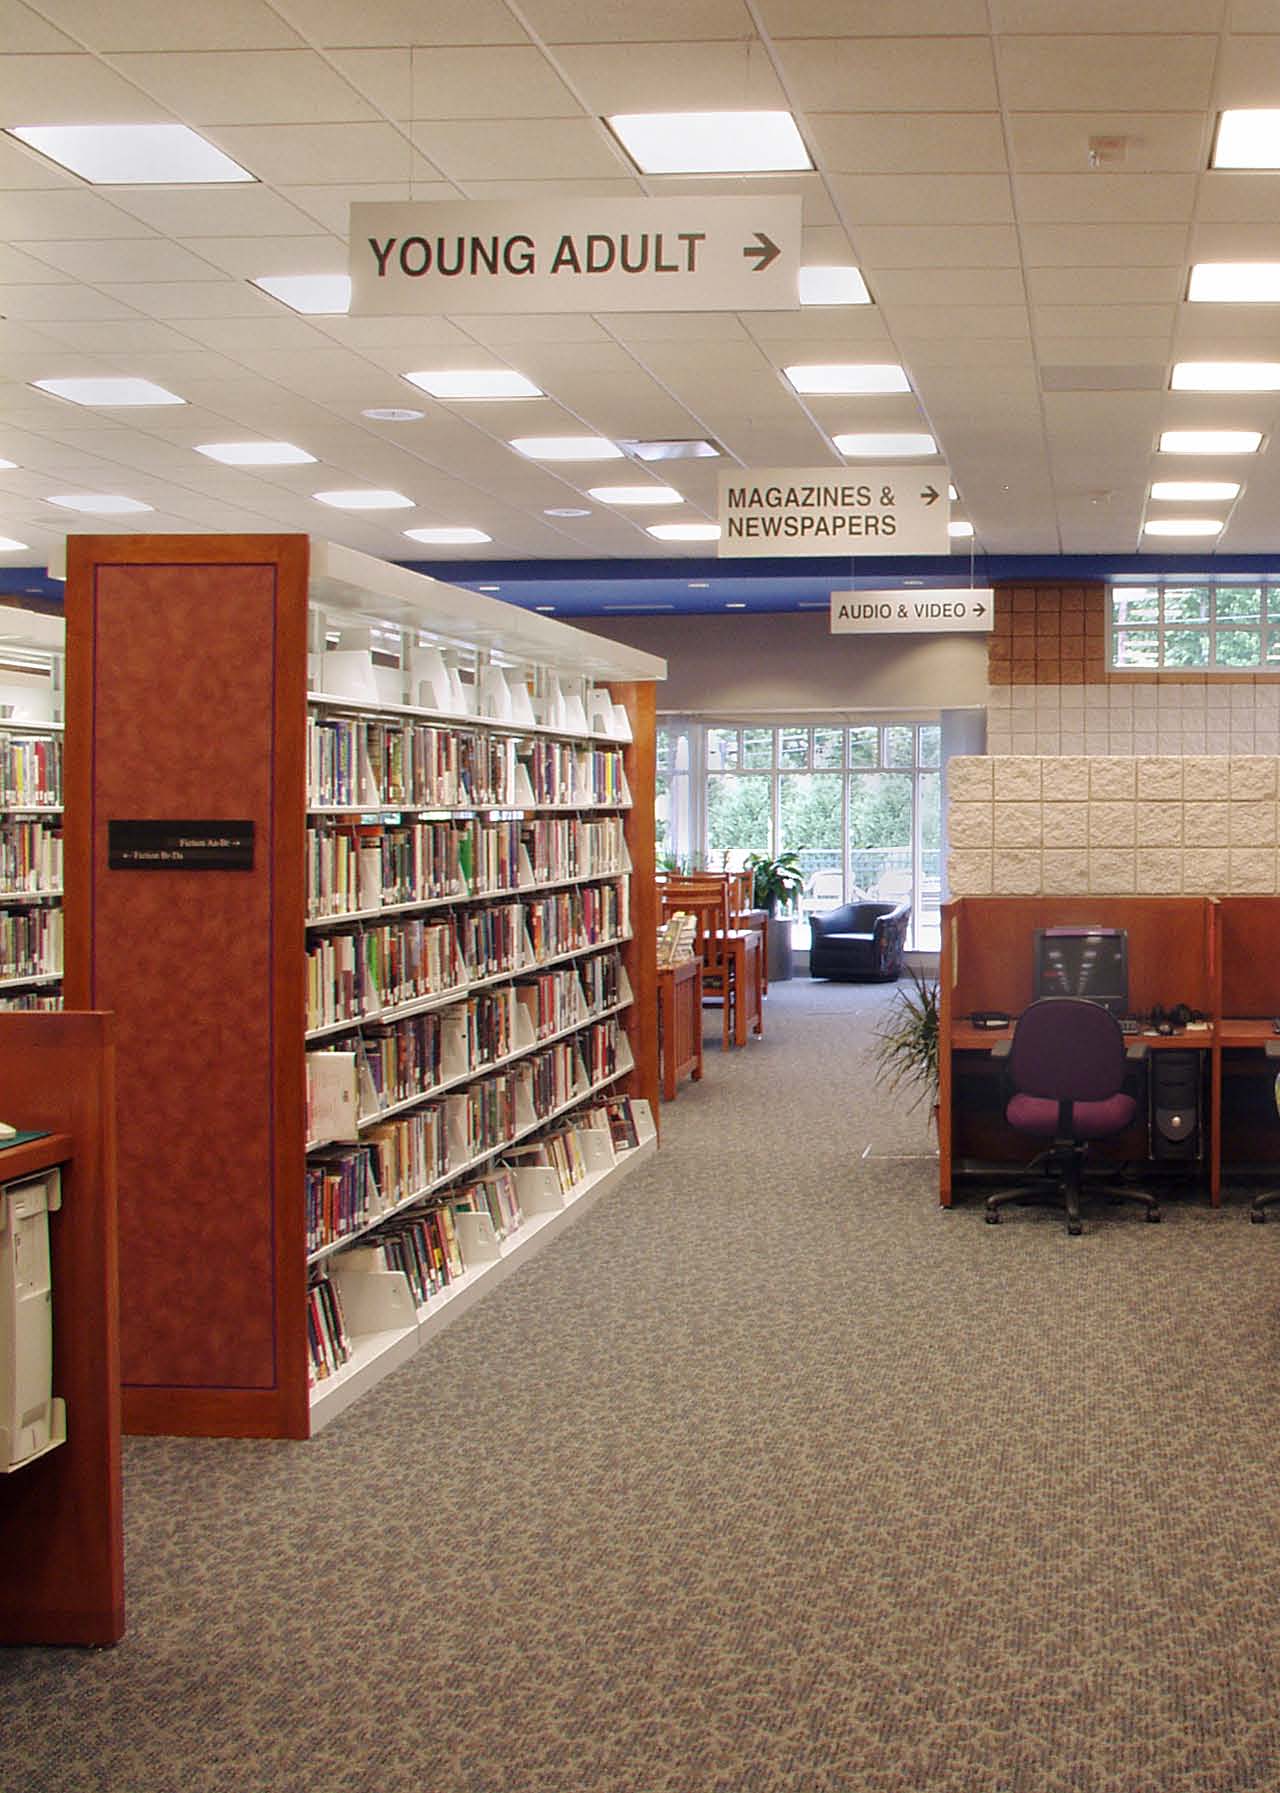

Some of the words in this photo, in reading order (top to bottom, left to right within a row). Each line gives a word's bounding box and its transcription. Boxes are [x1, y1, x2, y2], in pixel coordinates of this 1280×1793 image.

[368, 236, 535, 277] YOUNG
[551, 234, 706, 273] ADULT
[728, 486, 872, 508] MAGAZINES
[880, 486, 896, 507] &
[728, 515, 896, 537] NEWSPAPERS
[838, 604, 892, 620] AUDIO
[897, 604, 908, 618] &
[914, 603, 966, 618] VIDEO
[179, 839, 206, 848] Fiction
[133, 851, 160, 860] Fiction
